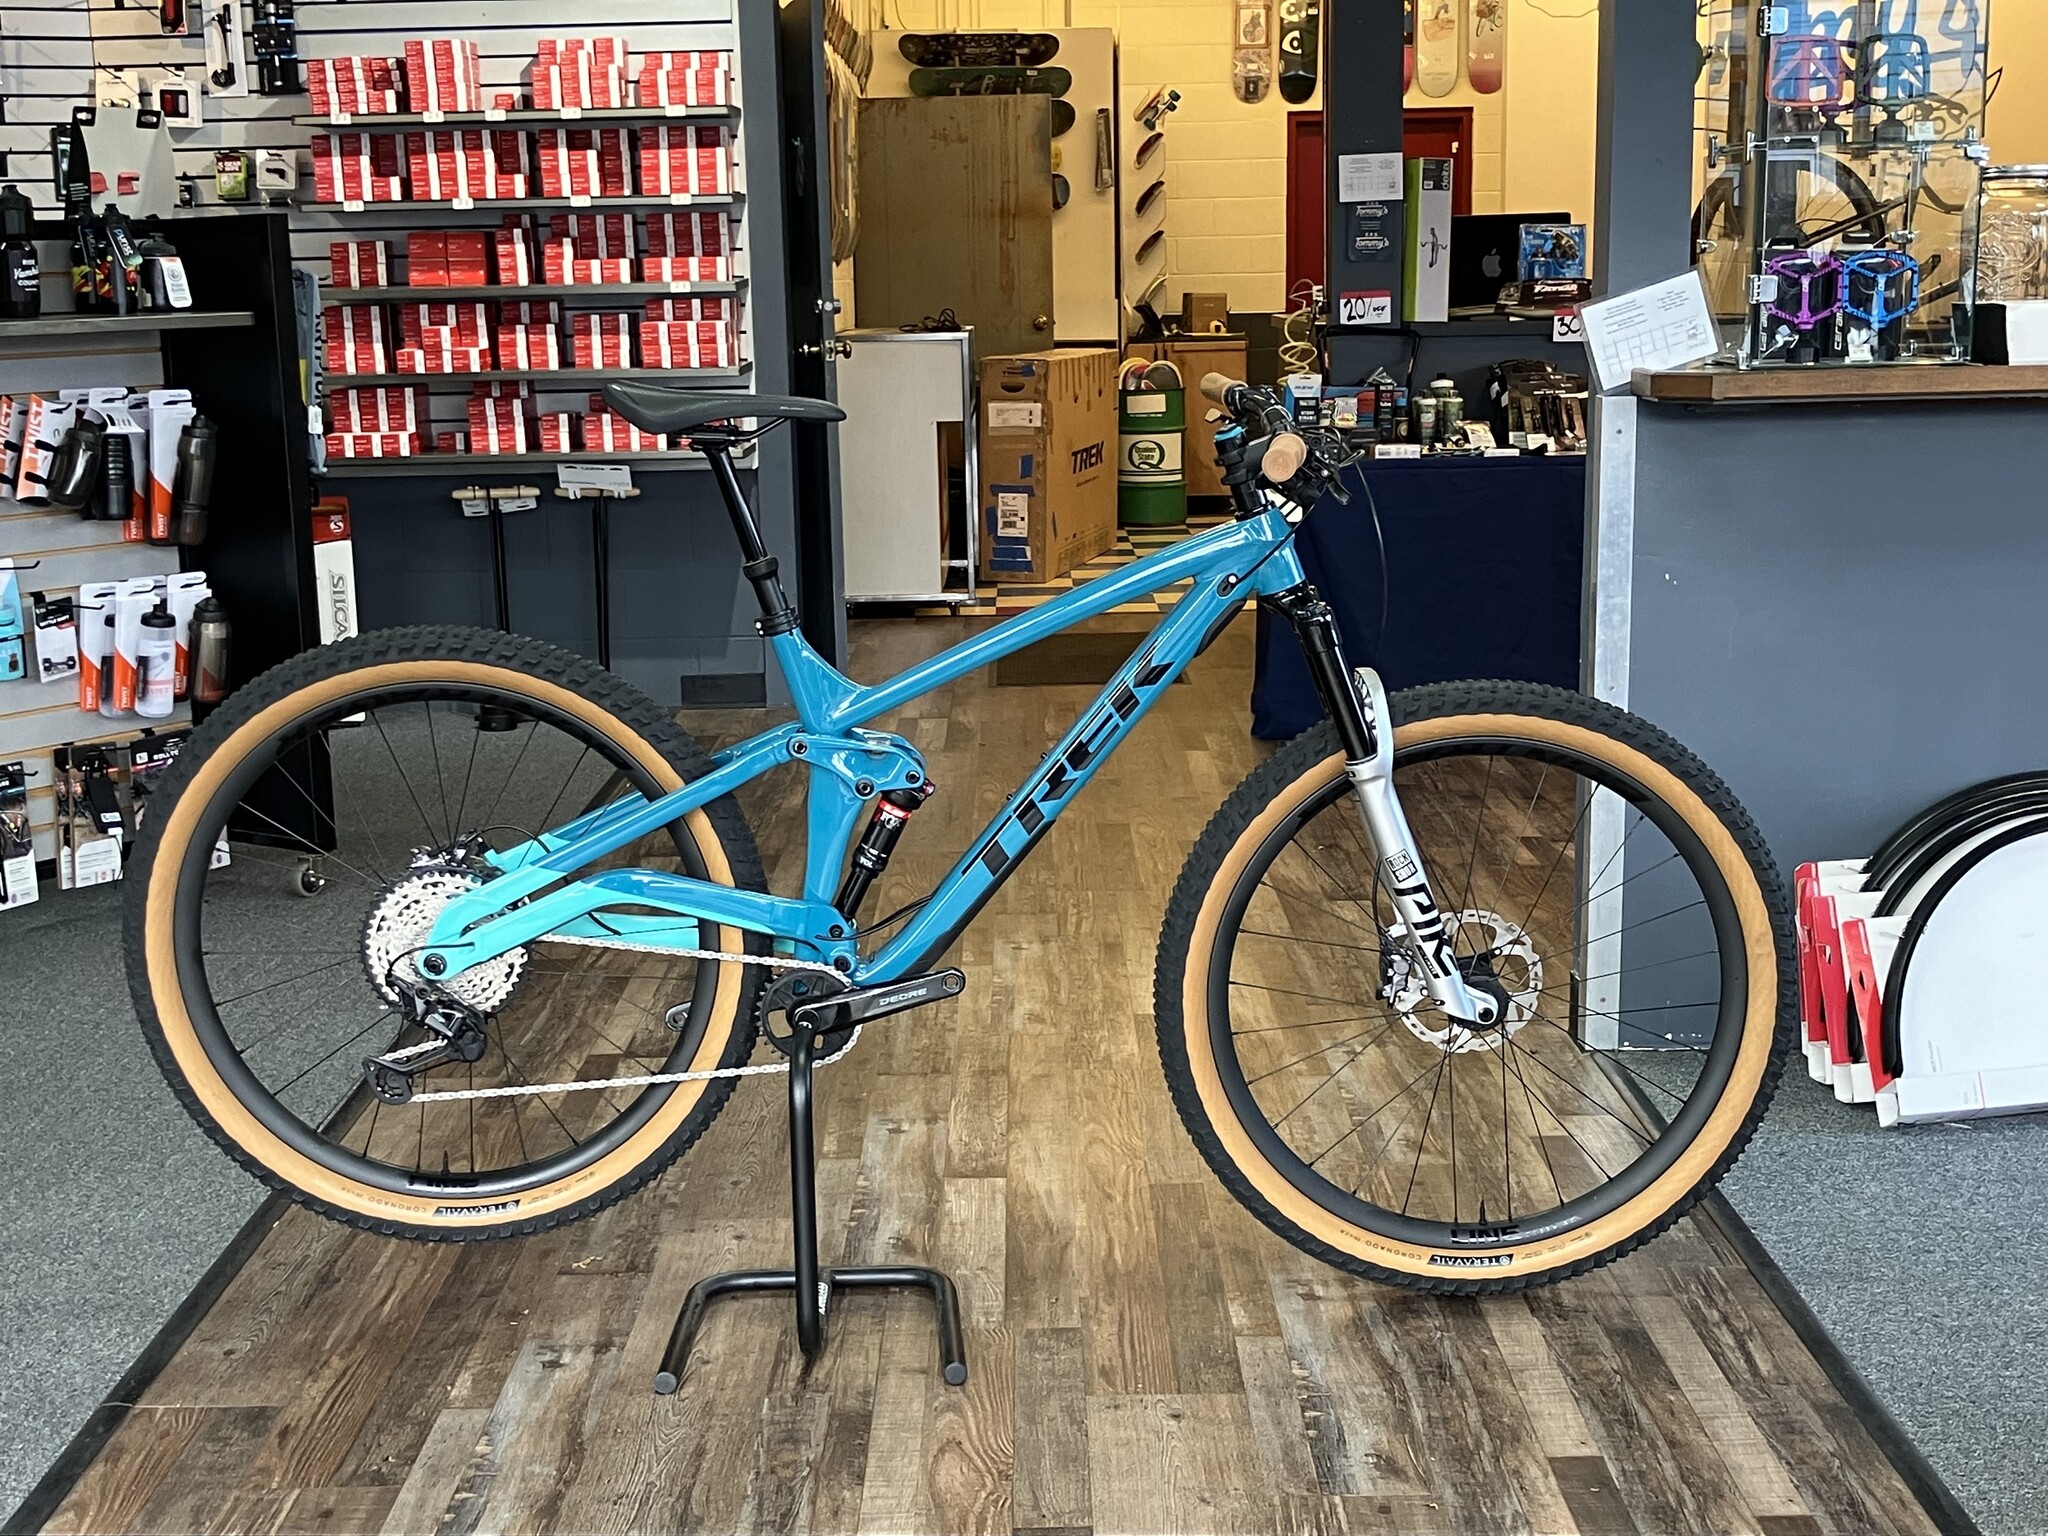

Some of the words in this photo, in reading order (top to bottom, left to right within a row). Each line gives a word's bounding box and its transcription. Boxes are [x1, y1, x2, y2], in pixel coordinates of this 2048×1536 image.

[1356, 204, 1388, 217] Tommy's
[112, 228, 135, 257] Purist
[1355, 235, 1390, 250] Tommy's
[24, 401, 44, 460] TWIST
[1071, 440, 1104, 475] TREK
[330, 571, 350, 640] SILCA
[962, 638, 1176, 877] TREK
[879, 811, 903, 831] FOX
[879, 987, 928, 1006] DEORE
[367, 1196, 428, 1213] CORONADO
[438, 1201, 508, 1217] TERAVAIL
[1364, 1240, 1422, 1261] CORONADO
[1433, 1254, 1500, 1267] TERAVAIL
